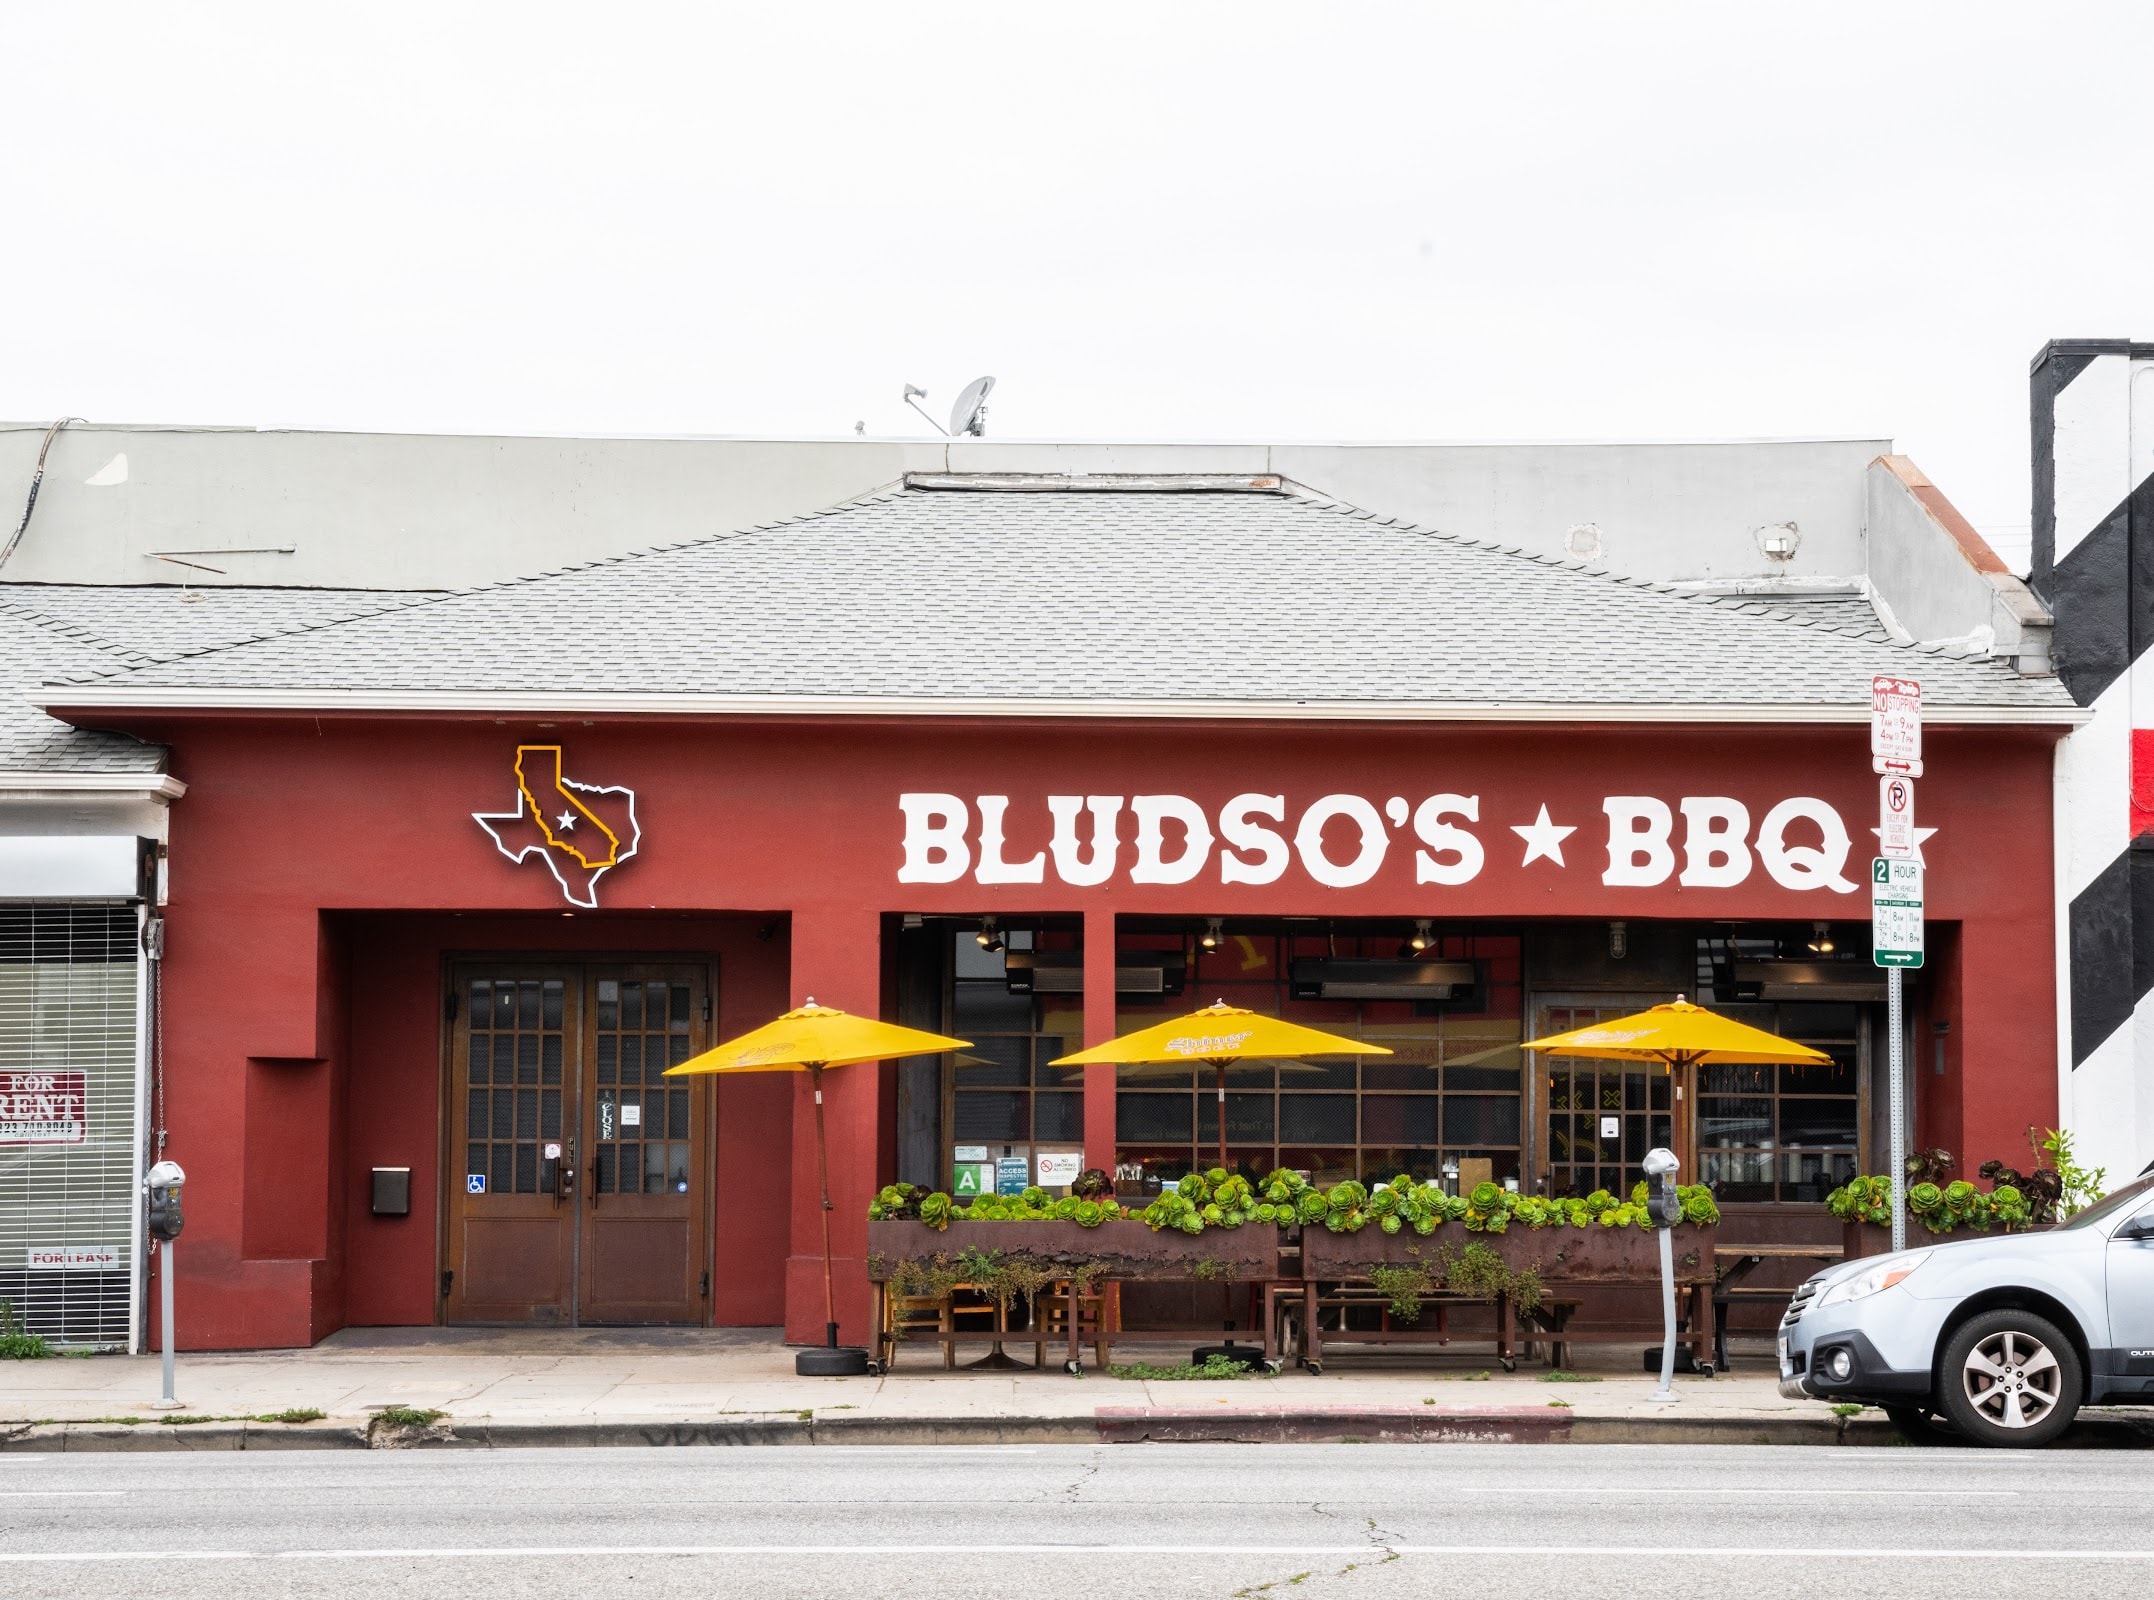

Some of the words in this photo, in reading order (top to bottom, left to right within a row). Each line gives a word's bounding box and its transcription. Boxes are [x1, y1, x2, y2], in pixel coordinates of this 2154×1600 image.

[1873, 692, 1887, 711] NO
[1888, 695, 1919, 714] STOPPING
[898, 793, 1485, 888] BLUDSO'S
[1601, 796, 1860, 894] BBQ
[1877, 861, 1887, 881] 2
[1894, 865, 1917, 879] HOUR
[1879, 884, 1898, 893] ELECTRIC
[1900, 885, 1917, 893] VEHICLE
[10, 1075, 56, 1091] FOR
[958, 1171, 977, 1190] A
[33, 1253, 63, 1264] FOR
